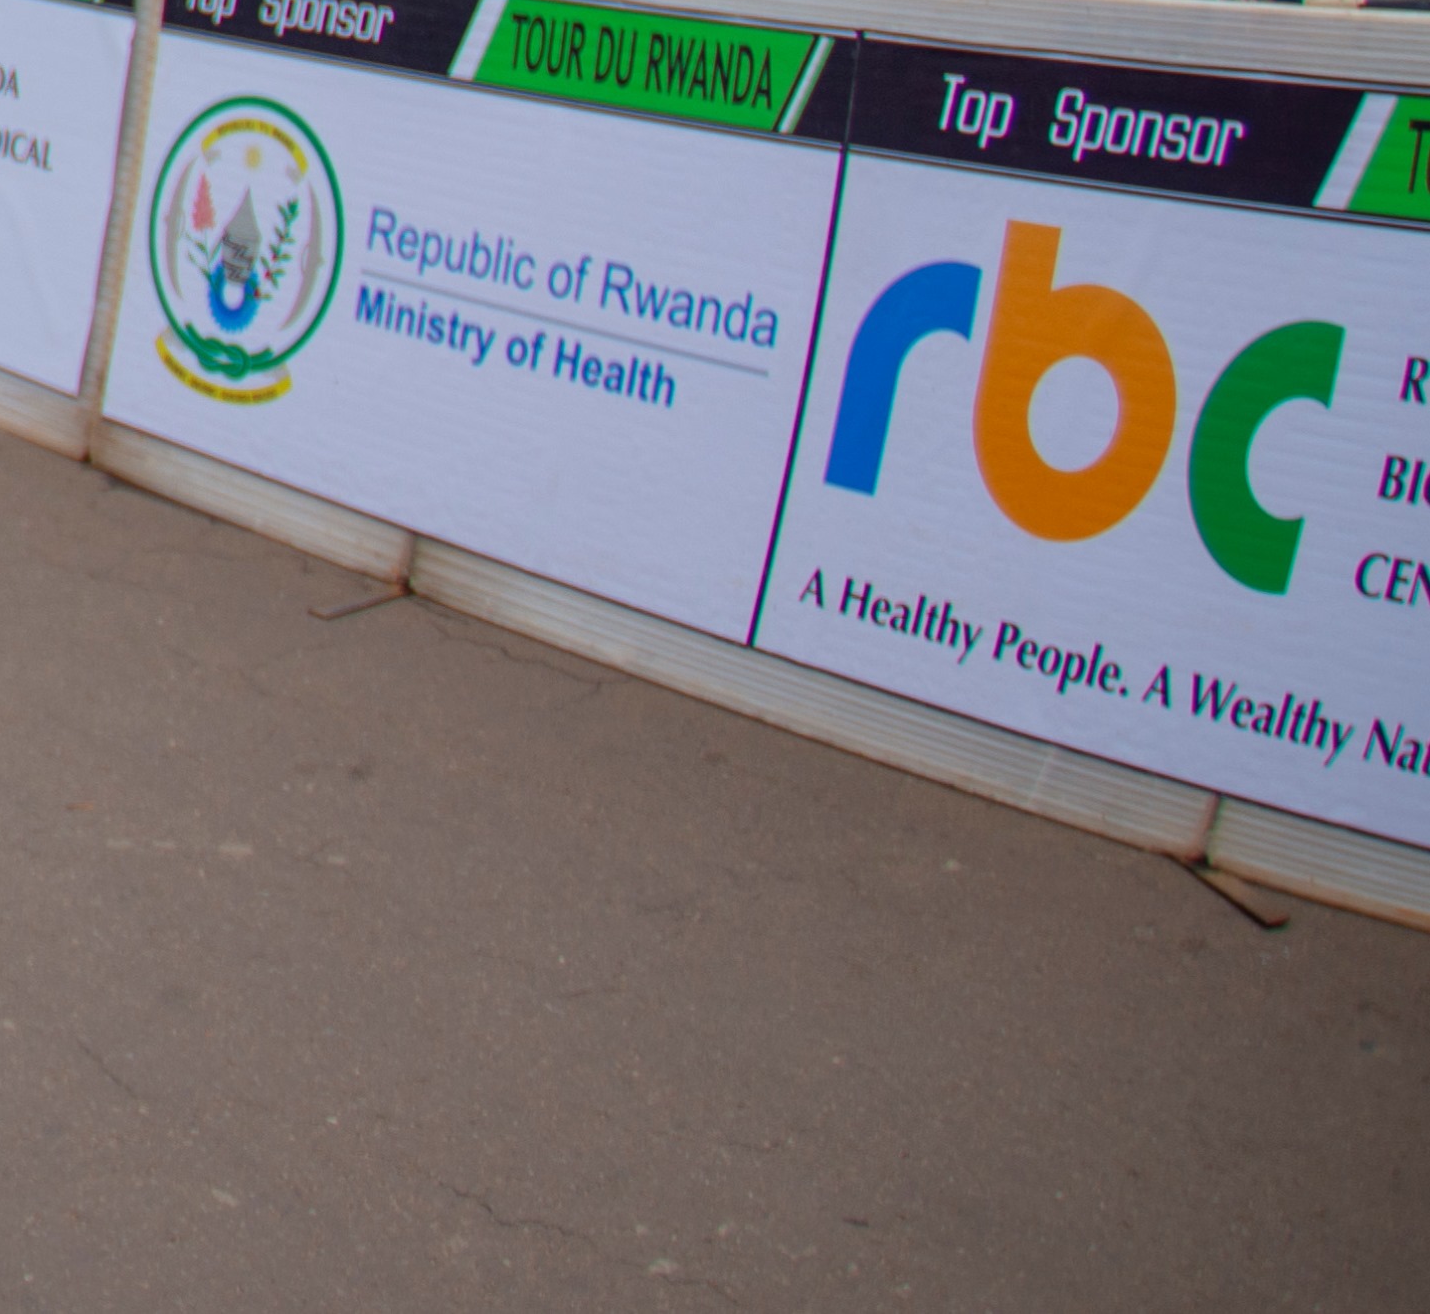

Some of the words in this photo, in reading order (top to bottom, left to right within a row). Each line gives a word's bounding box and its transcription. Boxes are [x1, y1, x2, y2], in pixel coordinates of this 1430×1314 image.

[511, 11, 585, 86] TOUR
[594, 23, 642, 88] DU
[646, 31, 775, 113] RWANDA
[937, 71, 1015, 147] Top
[1048, 86, 1247, 167] Sponsor
[355, 282, 498, 368] Ministry
[506, 317, 548, 374] of
[553, 332, 678, 409] Health
[366, 205, 540, 294] Republic
[546, 250, 595, 306] of
[599, 261, 782, 352] Rwanda
[822, 217, 1347, 597] rbc
[799, 566, 829, 611] A
[838, 574, 985, 666] Healthy
[991, 618, 1128, 698] People.
[1143, 662, 1173, 710] A
[1190, 671, 1356, 769] Wealthy
